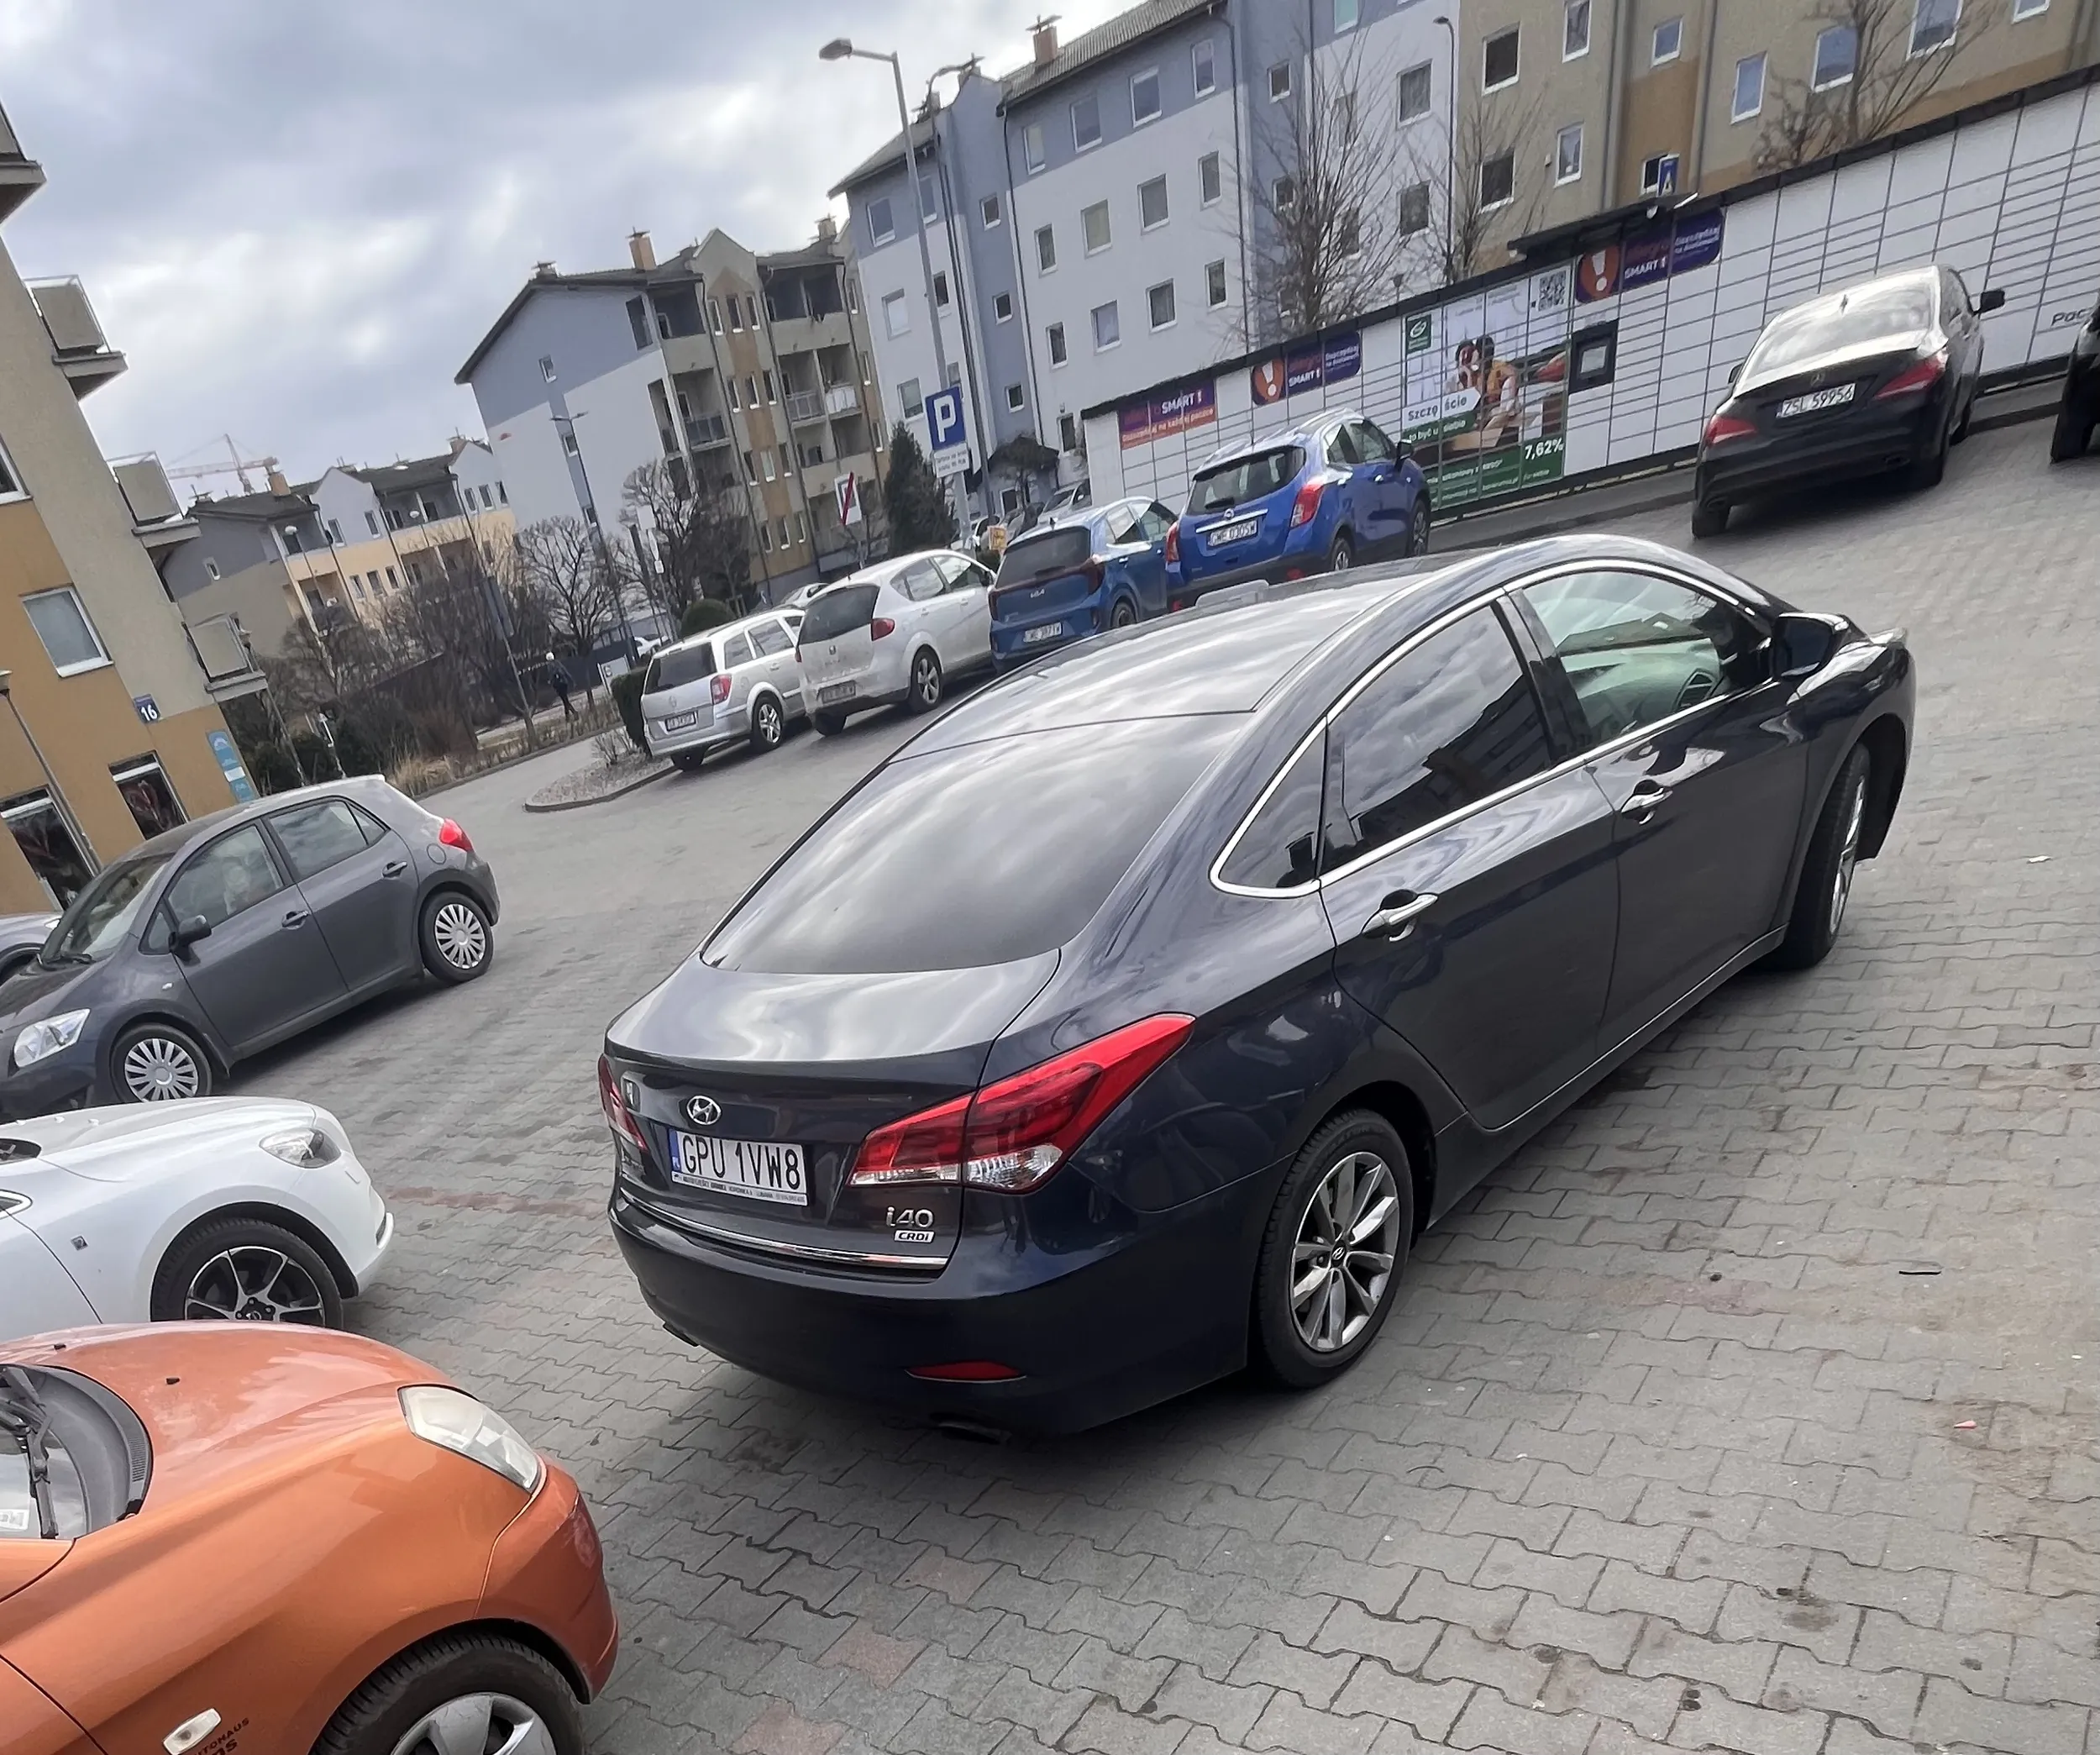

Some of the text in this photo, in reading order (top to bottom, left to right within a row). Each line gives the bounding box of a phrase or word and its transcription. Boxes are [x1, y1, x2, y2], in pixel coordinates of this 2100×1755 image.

[1625, 260, 1658, 279] SMART
[1289, 370, 1315, 387] SMART
[1162, 392, 1195, 414] SMART
[1783, 386, 1853, 416] ZSL 59956
[933, 395, 956, 442] P
[1525, 437, 1564, 460] 7,62%
[140, 704, 157, 721] 16
[682, 1135, 726, 1178] GPU
[735, 1142, 801, 1190] 1VW8
[886, 1206, 933, 1228] i40
